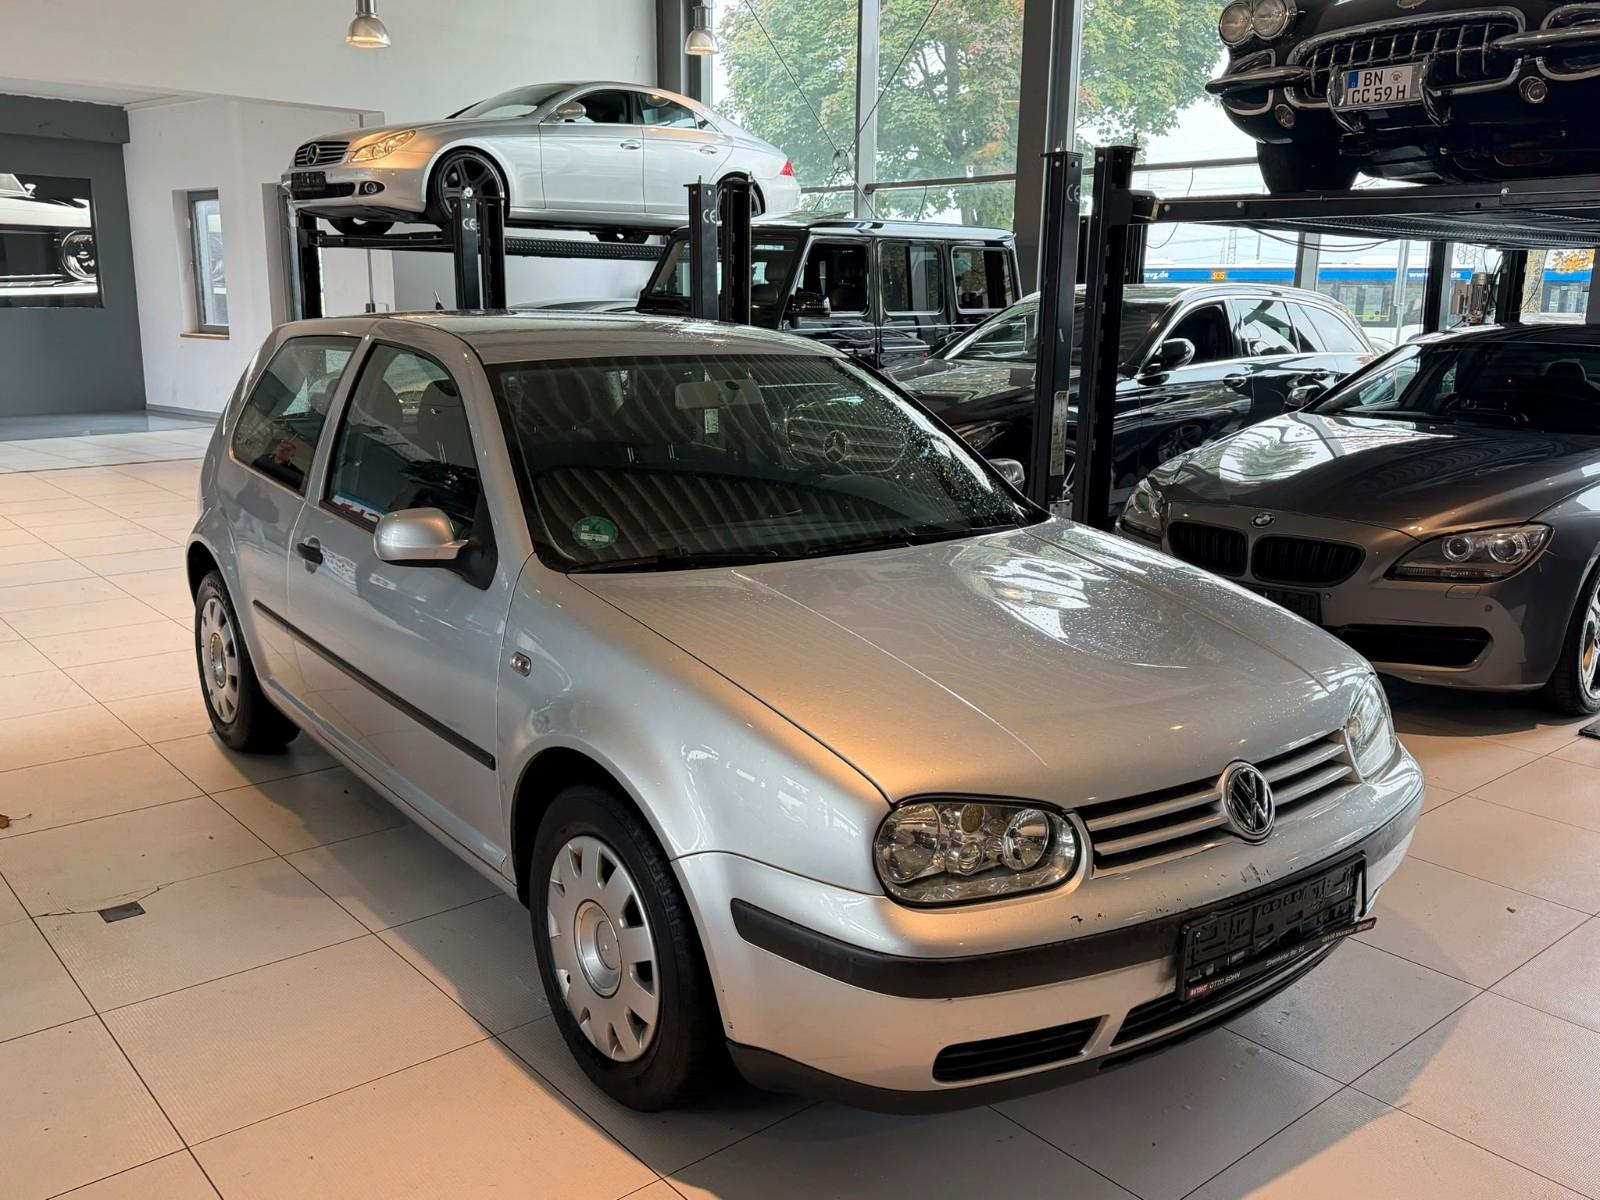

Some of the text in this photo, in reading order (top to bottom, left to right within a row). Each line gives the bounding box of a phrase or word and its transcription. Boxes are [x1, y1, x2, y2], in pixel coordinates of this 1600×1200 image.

[1364, 70, 1384, 87] BN
[1351, 84, 1407, 104] CC 59 H
[1066, 183, 1080, 202] CE
[462, 217, 477, 230] CE
[702, 209, 716, 224] CE
